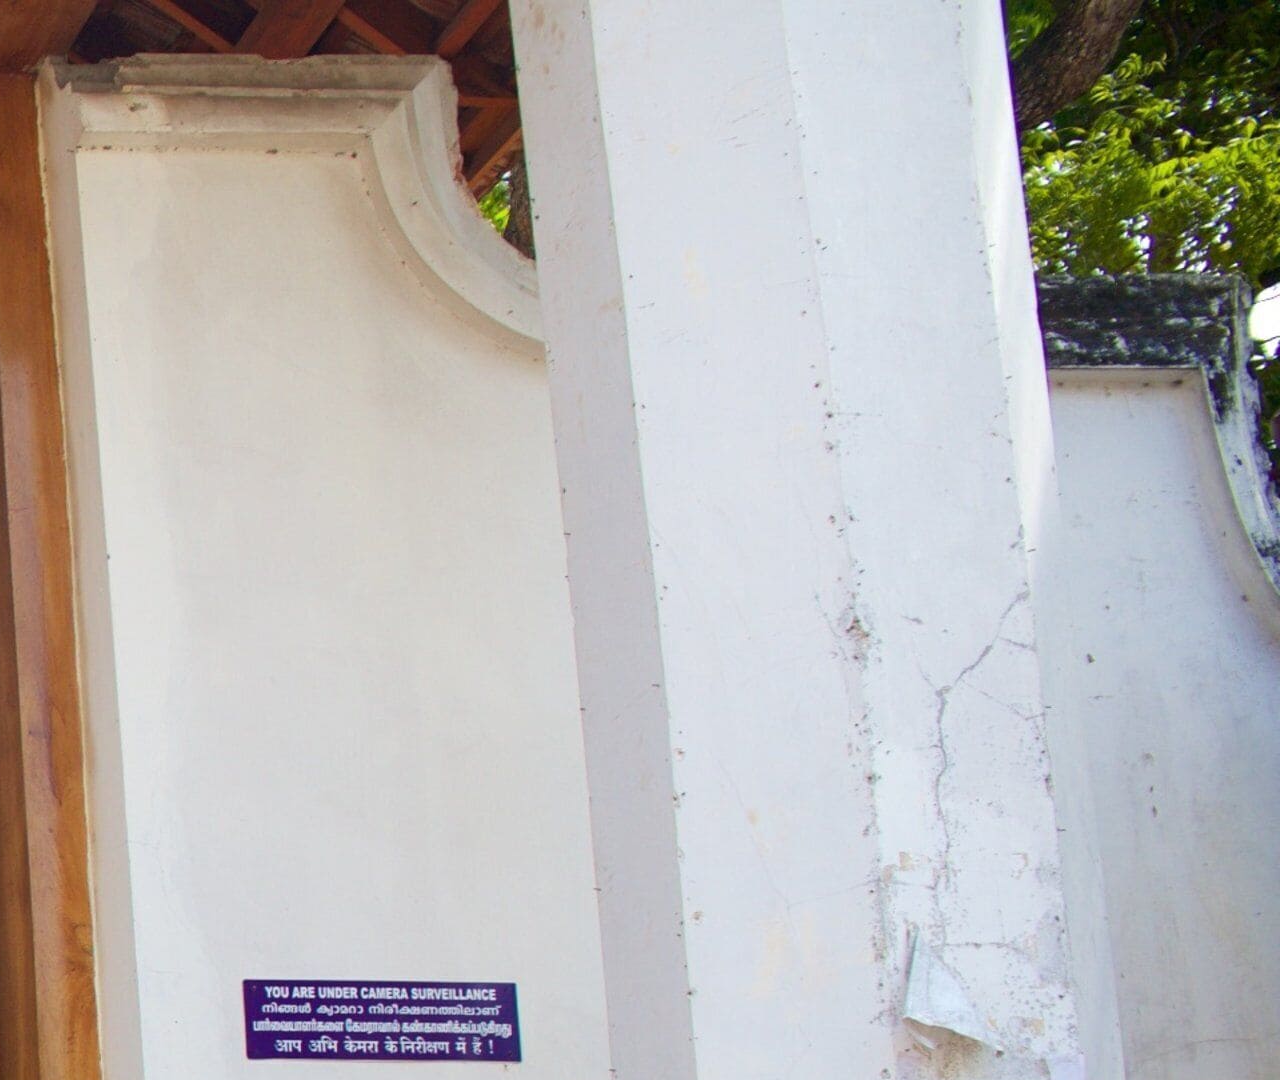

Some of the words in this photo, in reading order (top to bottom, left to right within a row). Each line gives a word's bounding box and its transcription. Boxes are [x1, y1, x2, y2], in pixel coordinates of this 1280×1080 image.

[264, 986, 289, 999] YOU
[292, 987, 316, 999] ARE
[318, 987, 358, 999] UNDER
[360, 987, 409, 1000] CAMERA
[411, 987, 497, 1001] SURVEILLANCE
[274, 1039, 302, 1053] आप
[343, 1036, 379, 1053] केमरा
[384, 1036, 398, 1053] के
[399, 1036, 450, 1054] निरीक्षण
[454, 1036, 467, 1054] में
